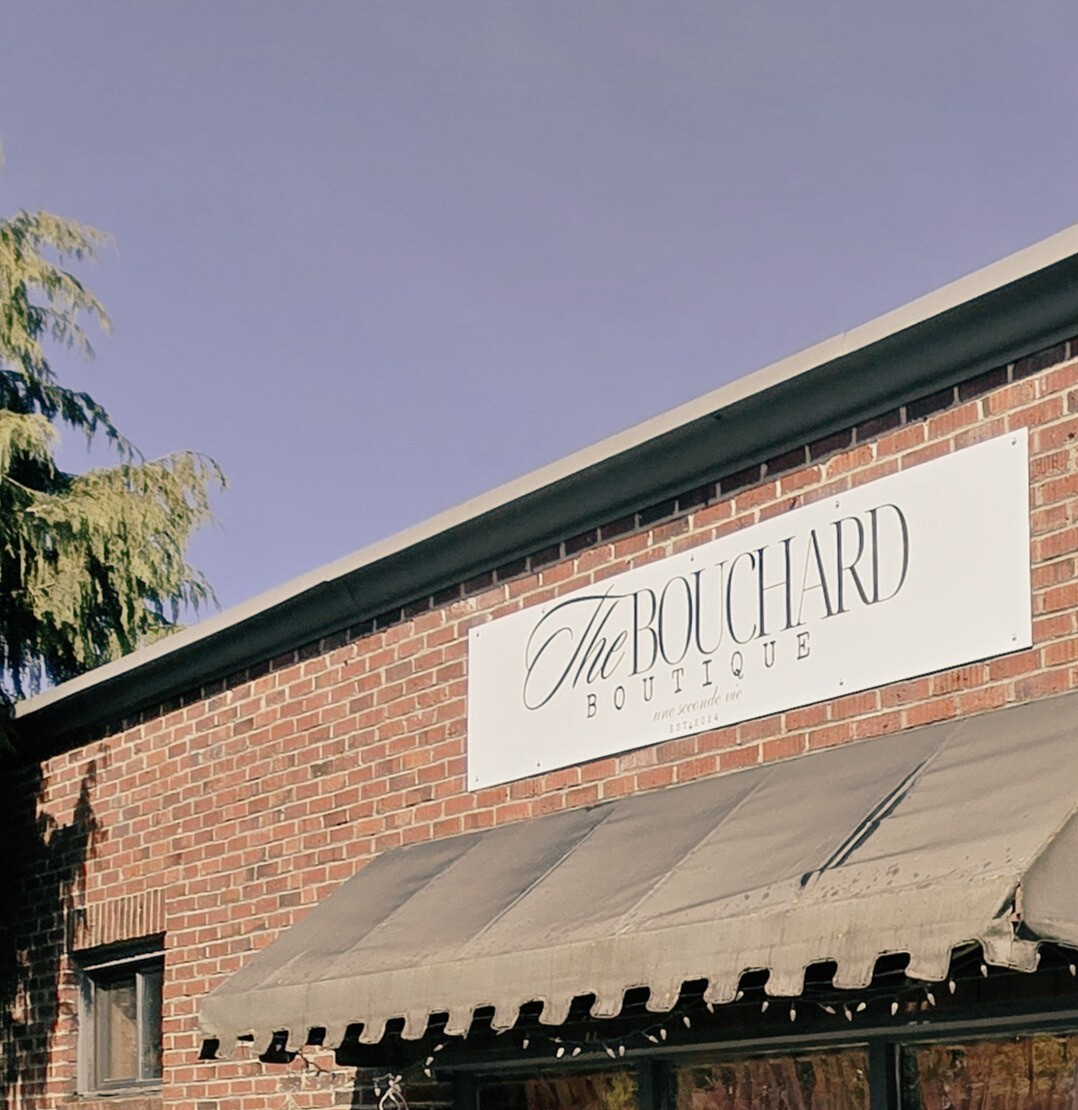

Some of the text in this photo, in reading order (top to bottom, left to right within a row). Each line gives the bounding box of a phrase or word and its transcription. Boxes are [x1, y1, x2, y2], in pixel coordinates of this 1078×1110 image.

[523, 503, 910, 711] The BOUCHARD
[586, 631, 811, 719] BOUTIQUE
